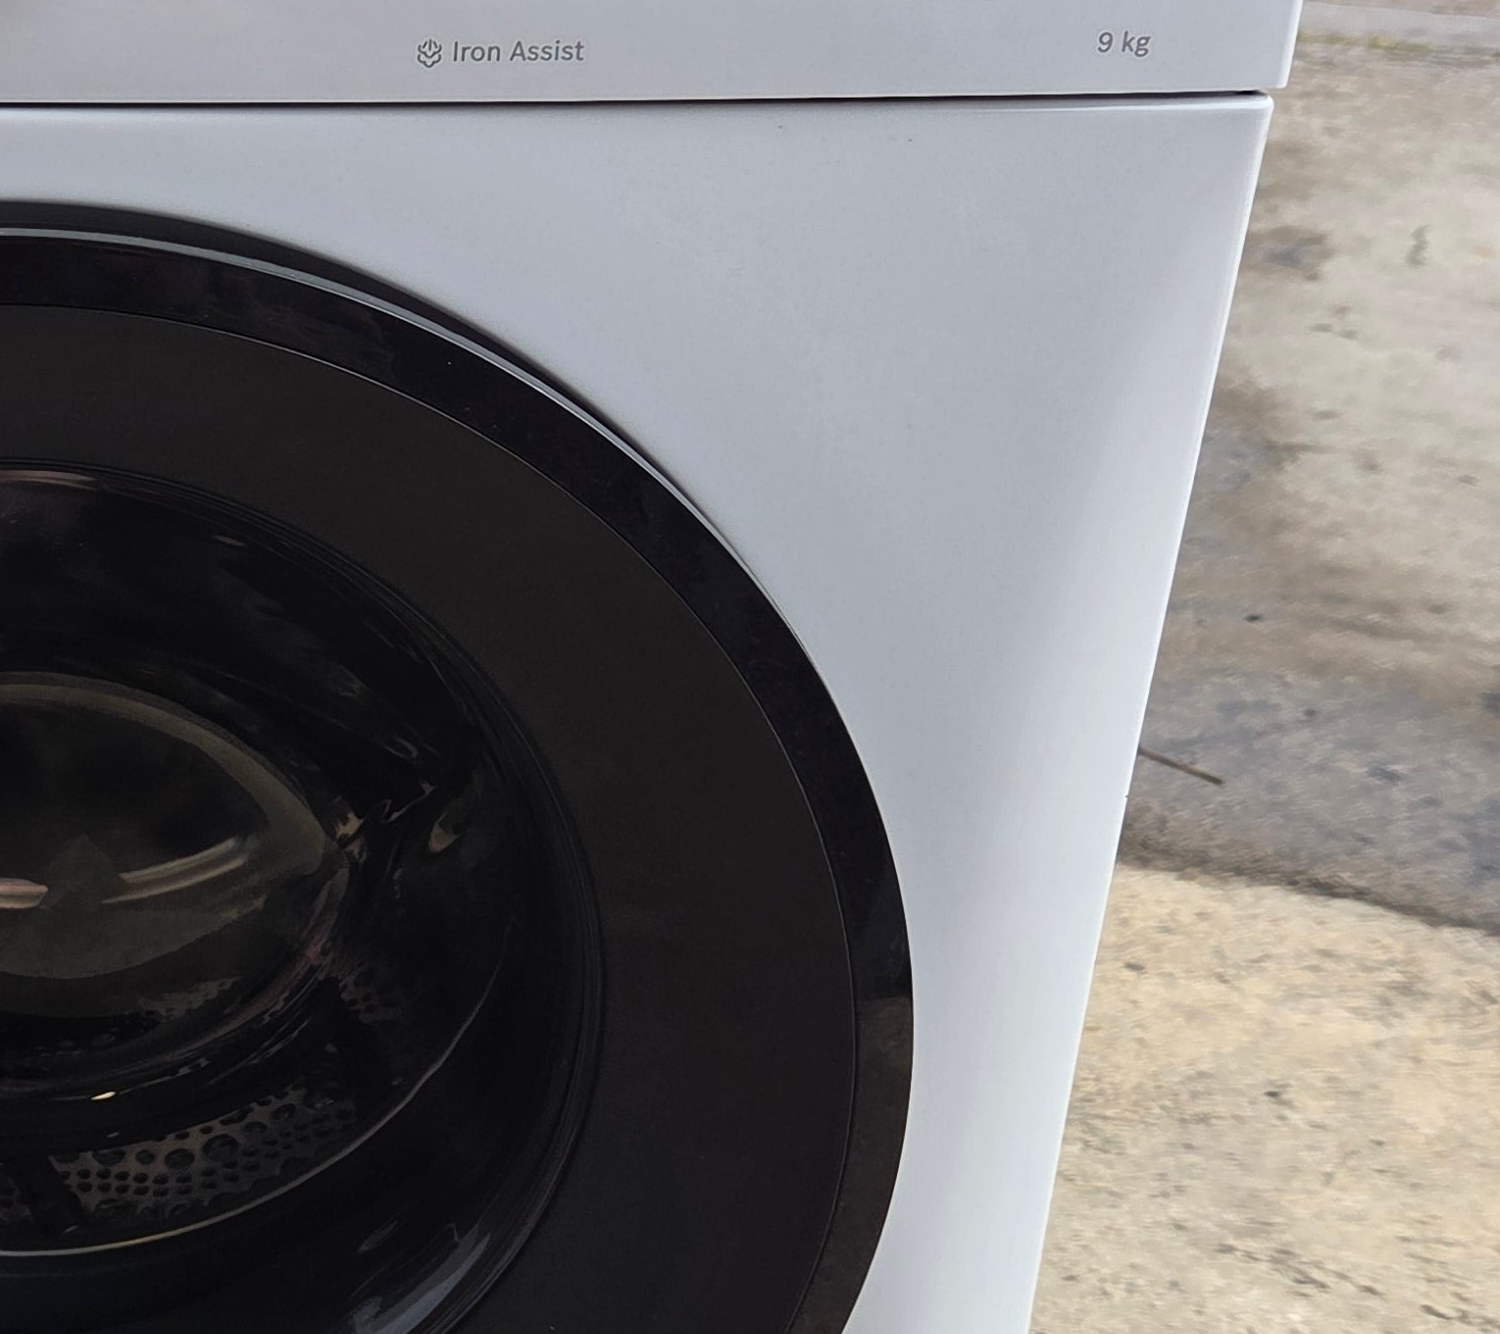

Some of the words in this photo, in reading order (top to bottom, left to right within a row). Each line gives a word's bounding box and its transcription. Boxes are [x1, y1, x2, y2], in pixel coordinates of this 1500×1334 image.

[453, 40, 501, 62] Iron
[509, 39, 585, 62] Assist
[1097, 31, 1114, 53] 9
[1121, 30, 1152, 58] kg
